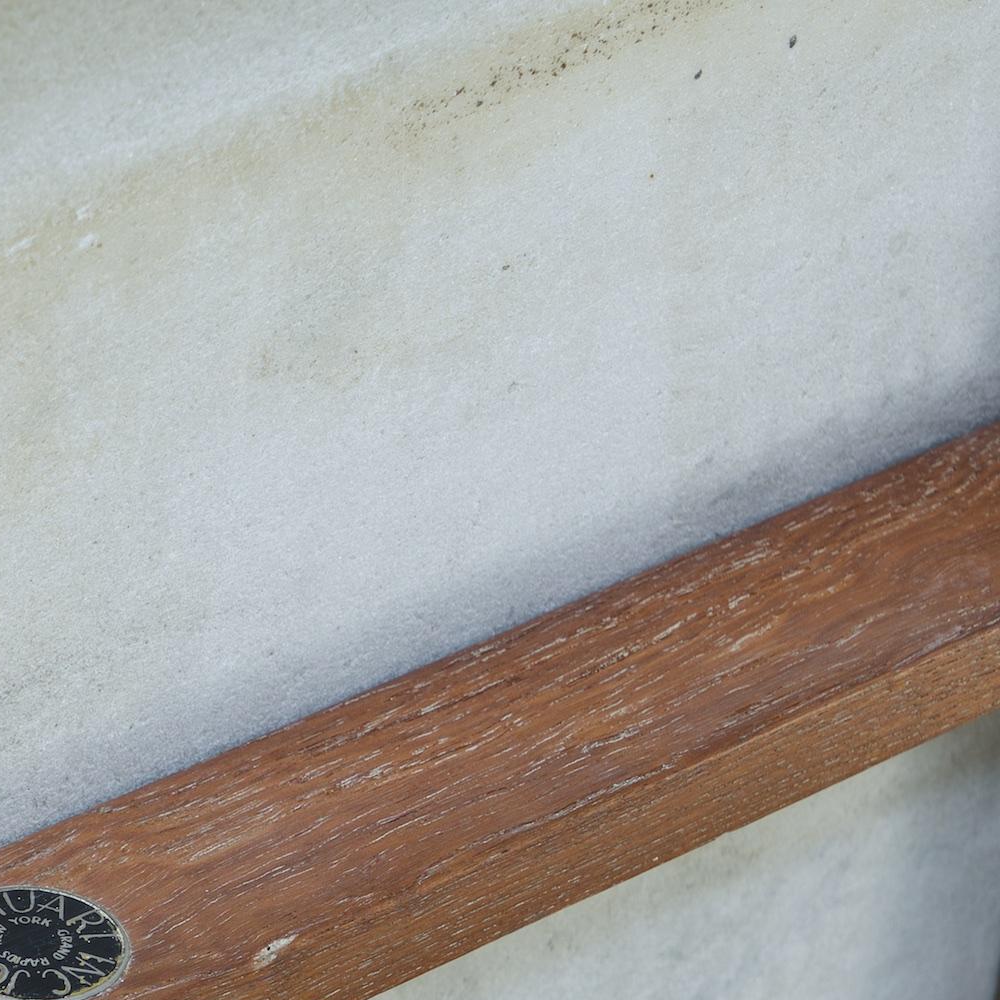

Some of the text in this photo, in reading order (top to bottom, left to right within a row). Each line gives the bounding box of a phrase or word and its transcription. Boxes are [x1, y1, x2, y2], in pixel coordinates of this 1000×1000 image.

[8, 916, 51, 927] YORK
[0, 929, 73, 967] GRAND RAPIDS
